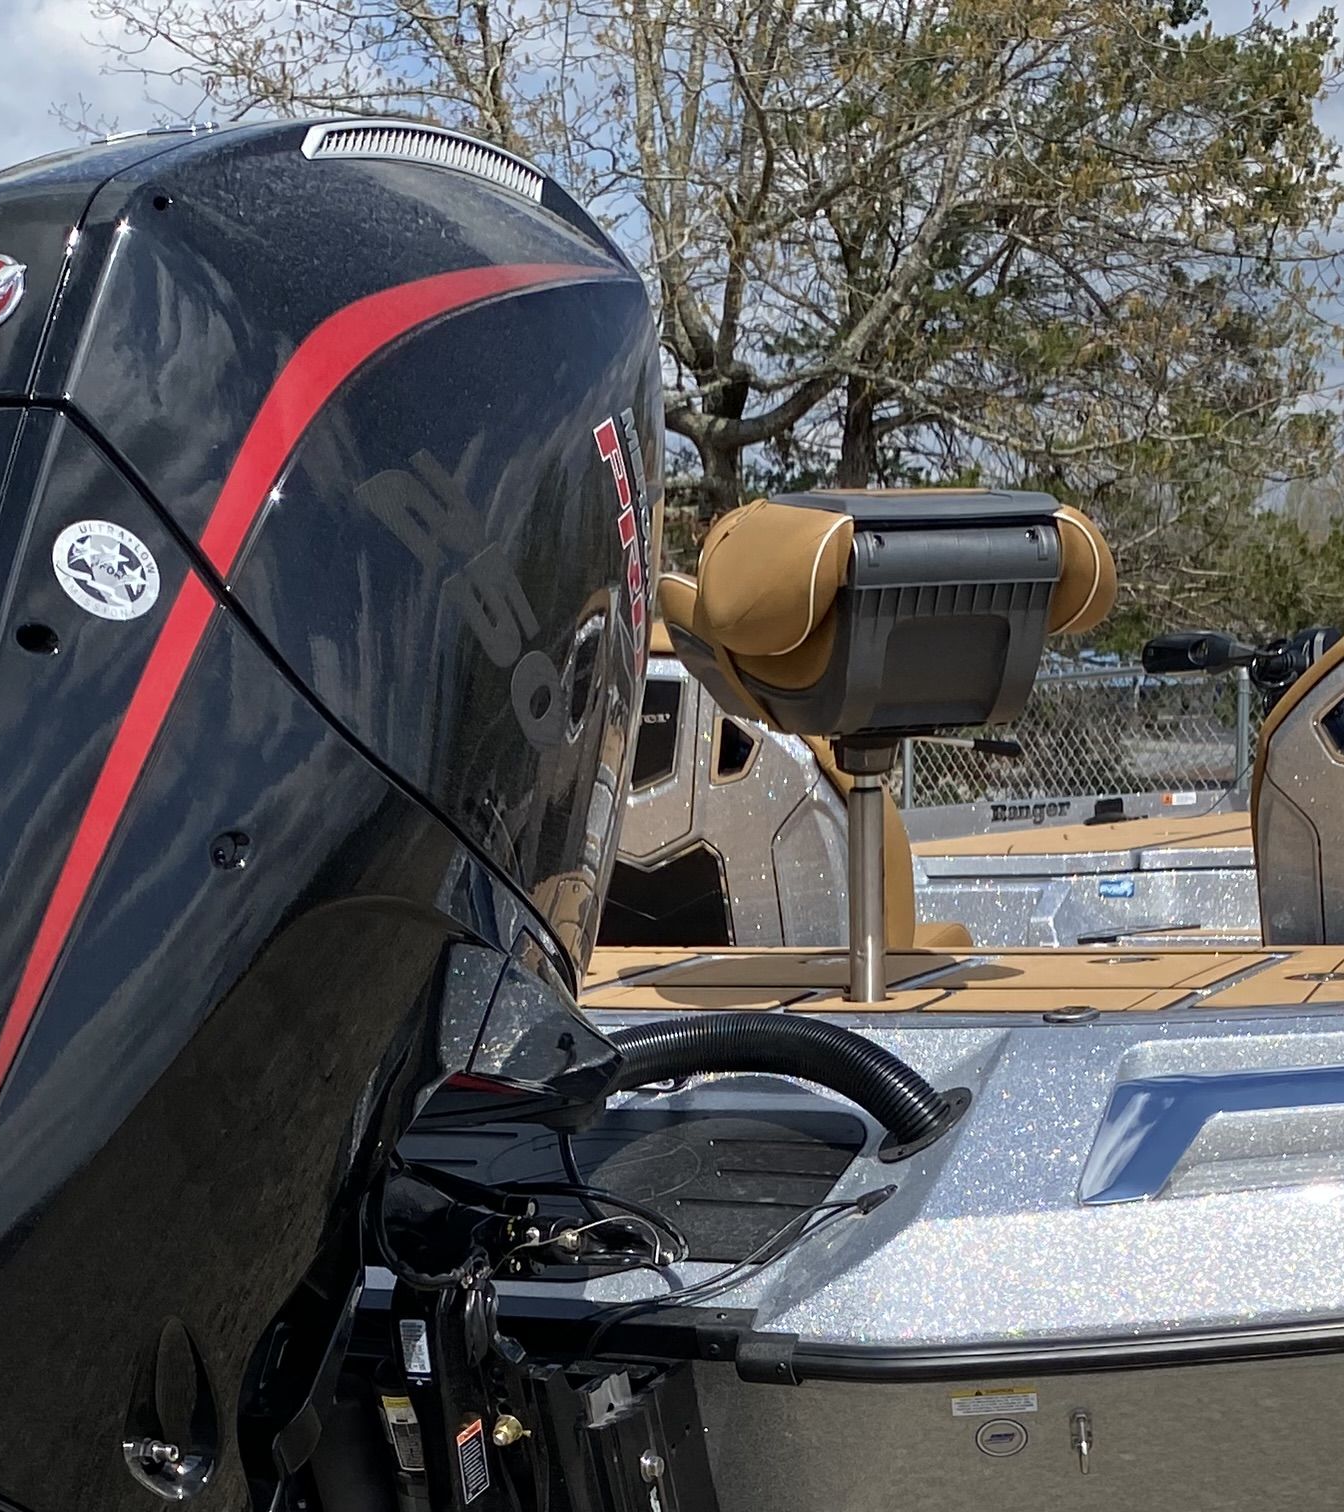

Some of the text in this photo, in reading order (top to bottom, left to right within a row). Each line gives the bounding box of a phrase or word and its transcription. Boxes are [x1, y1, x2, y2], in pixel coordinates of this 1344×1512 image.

[79, 523, 125, 542] ULTRA
[134, 544, 156, 574] LOW
[990, 801, 1071, 825] Ranger
